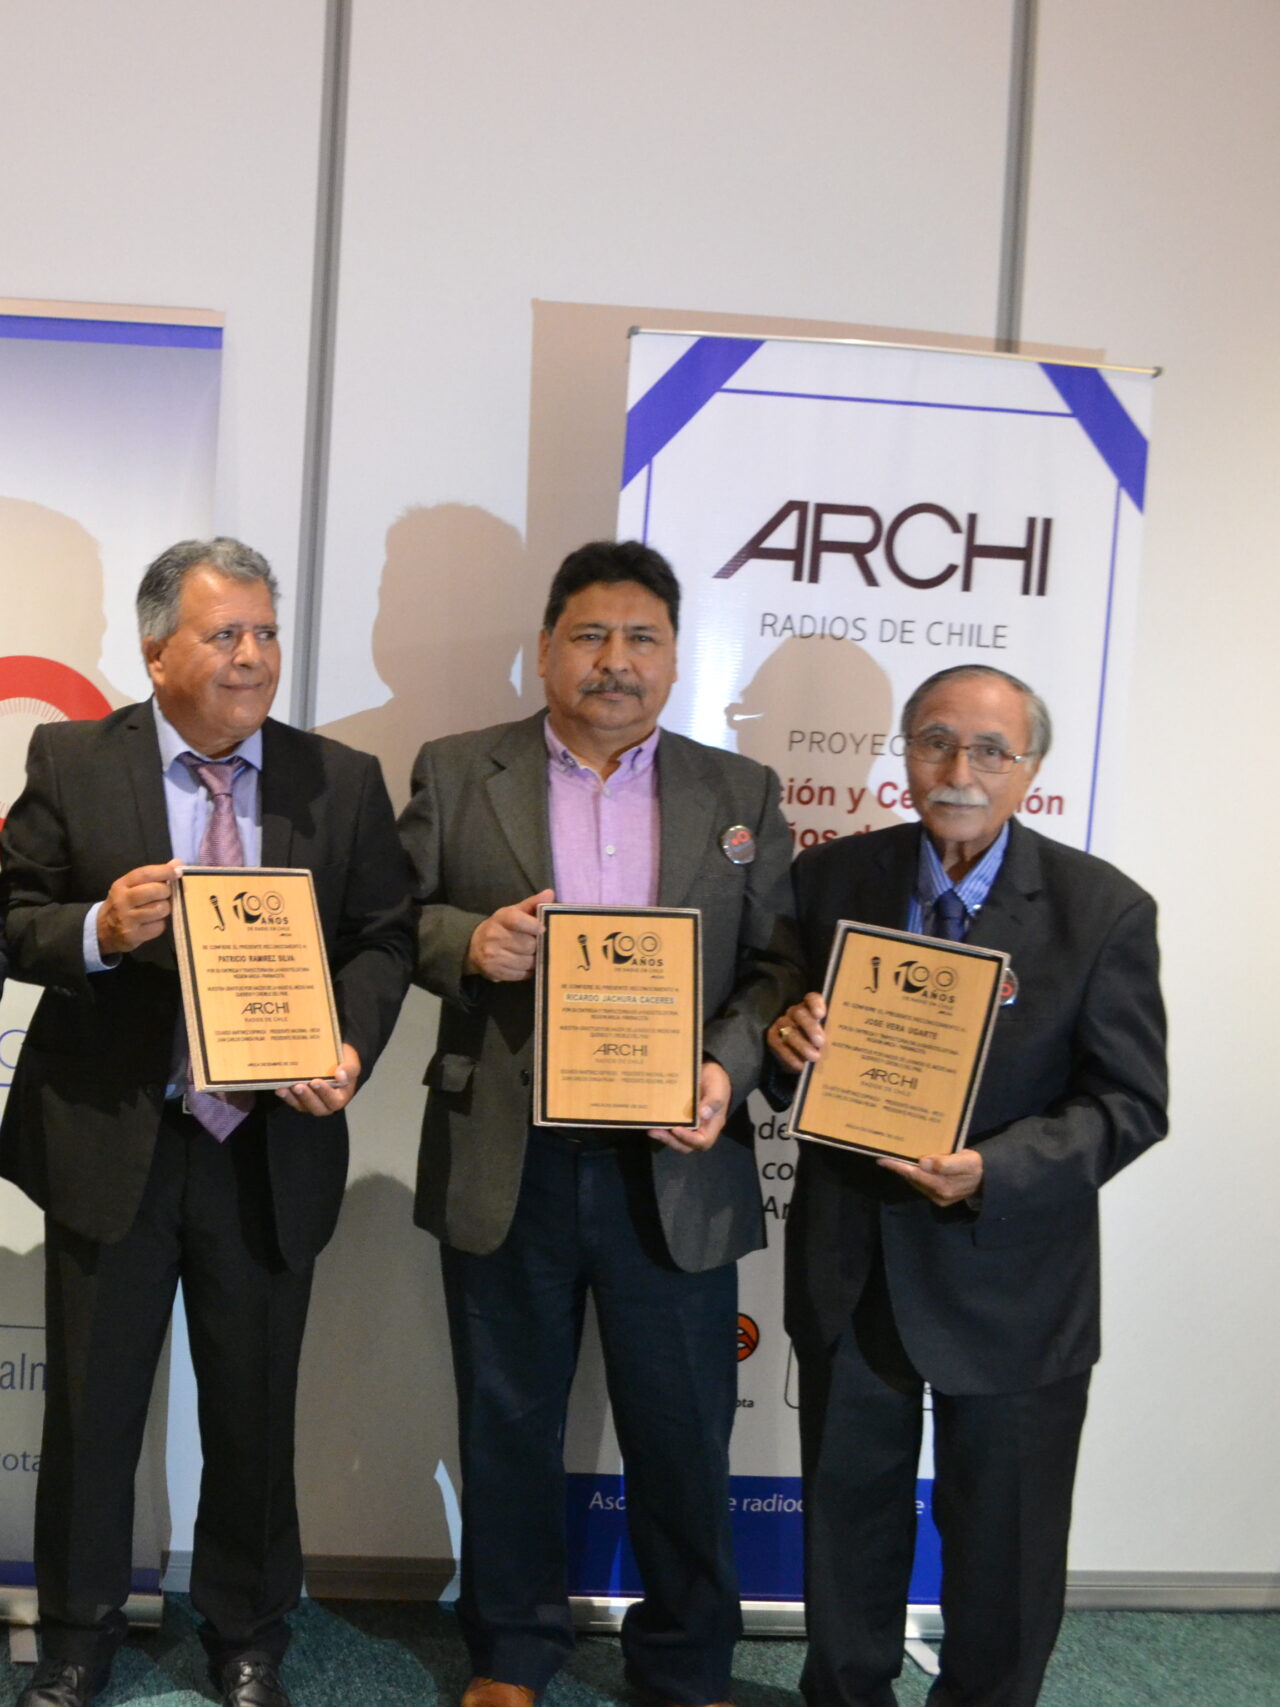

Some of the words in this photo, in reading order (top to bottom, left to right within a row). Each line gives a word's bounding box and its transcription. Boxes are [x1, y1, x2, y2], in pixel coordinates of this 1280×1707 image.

[711, 499, 1054, 597] ARCHI
[759, 612, 867, 642] RADIOS
[879, 618, 916, 645] DE
[926, 620, 1008, 650] CHILE
[846, 786, 868, 814] y
[631, 956, 664, 967] AÑOS
[241, 1001, 290, 1015] ARCHI
[593, 1043, 648, 1057] ARCHI
[859, 1068, 919, 1090] ARCHI
